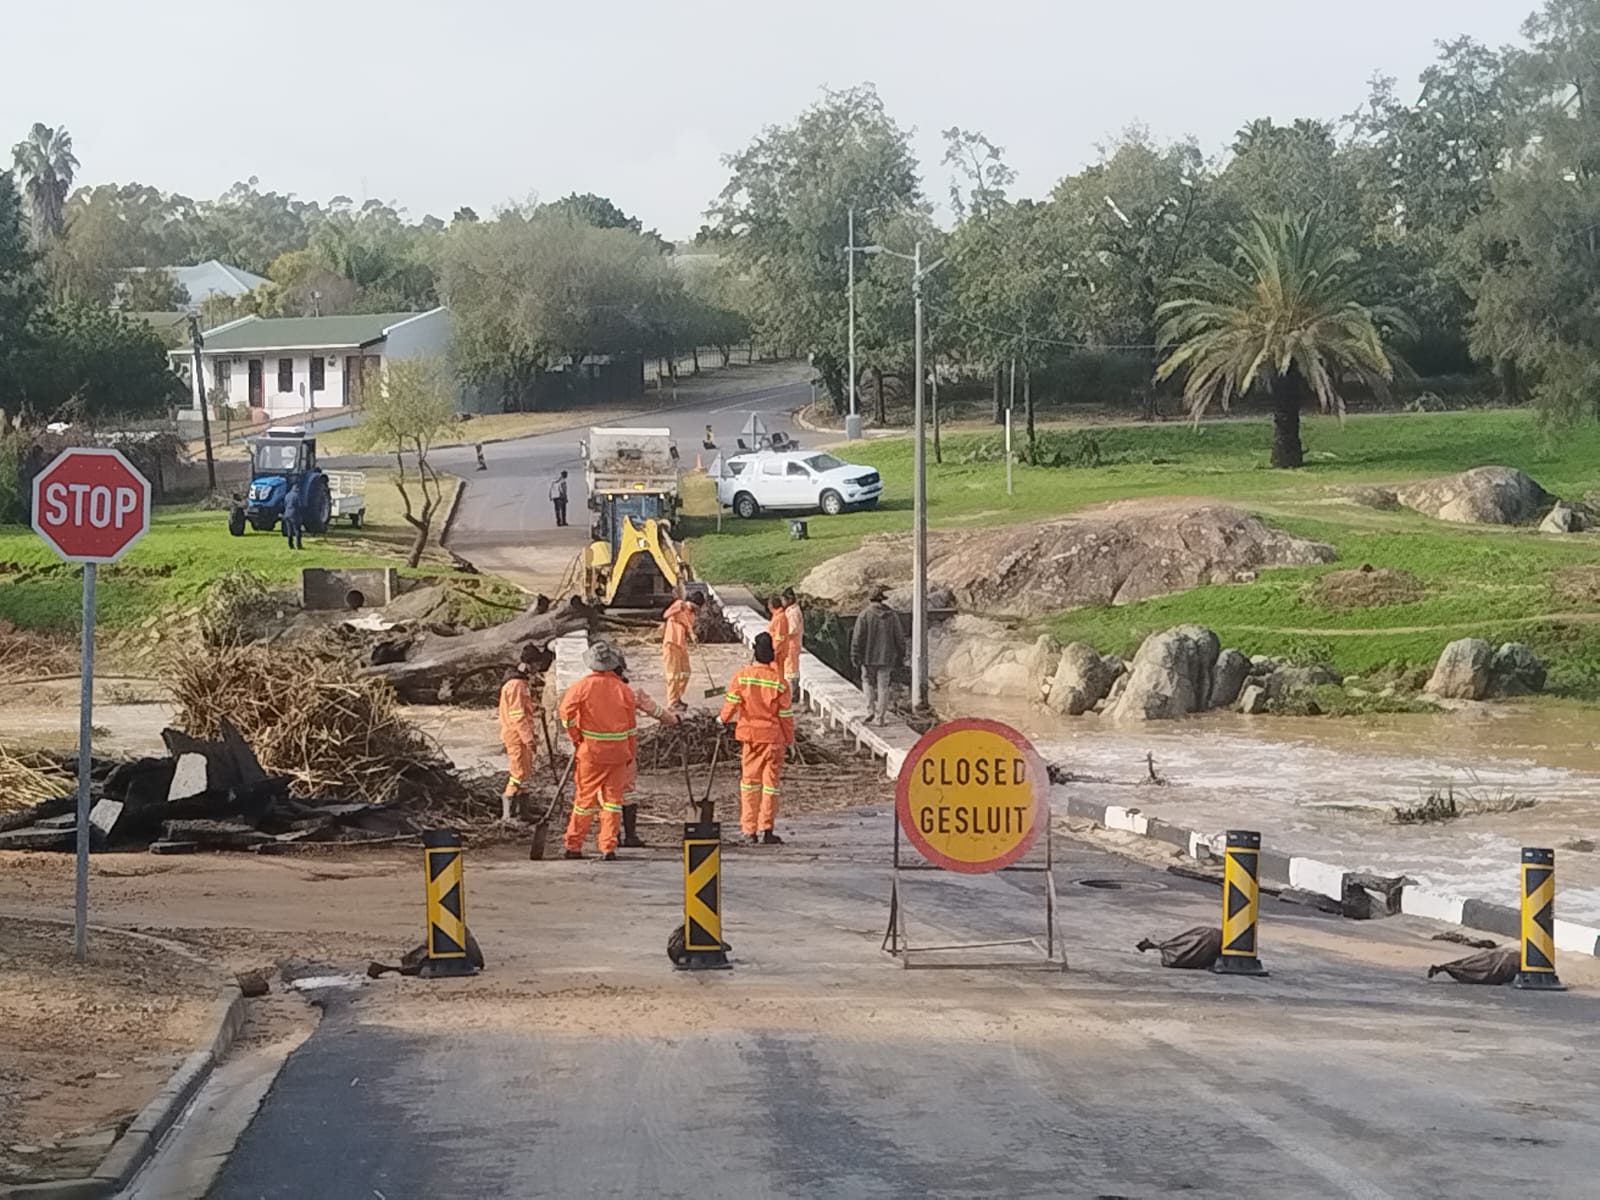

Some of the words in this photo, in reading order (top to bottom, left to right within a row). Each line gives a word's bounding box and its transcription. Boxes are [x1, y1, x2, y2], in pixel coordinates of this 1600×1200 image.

[45, 482, 137, 529] STOP
[922, 758, 1026, 786] CLOSED
[920, 806, 1028, 834] GESLUIT
